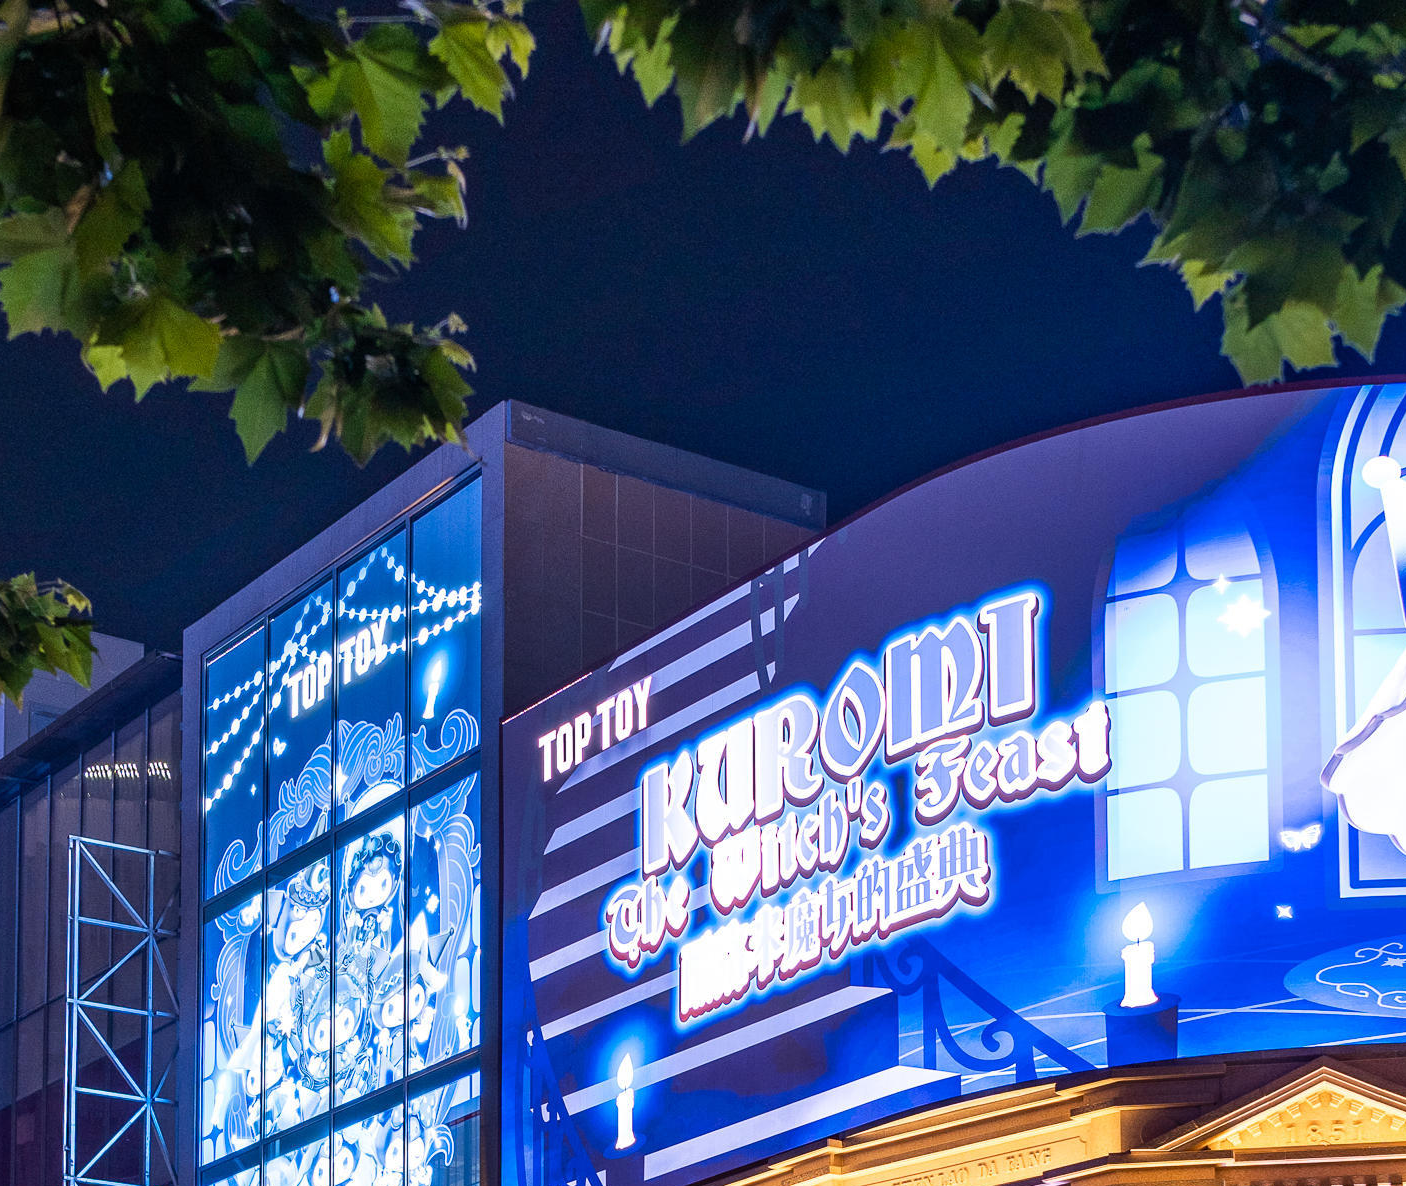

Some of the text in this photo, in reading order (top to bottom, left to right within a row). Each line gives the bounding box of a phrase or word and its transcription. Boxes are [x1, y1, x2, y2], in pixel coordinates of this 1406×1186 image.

[288, 620, 390, 718] TOP TOY
[538, 676, 653, 782] TOP TOY
[641, 592, 1039, 878] KUROMI
[606, 701, 1112, 968] The Witch's Feast
[1285, 1119, 1365, 1146] 1851
